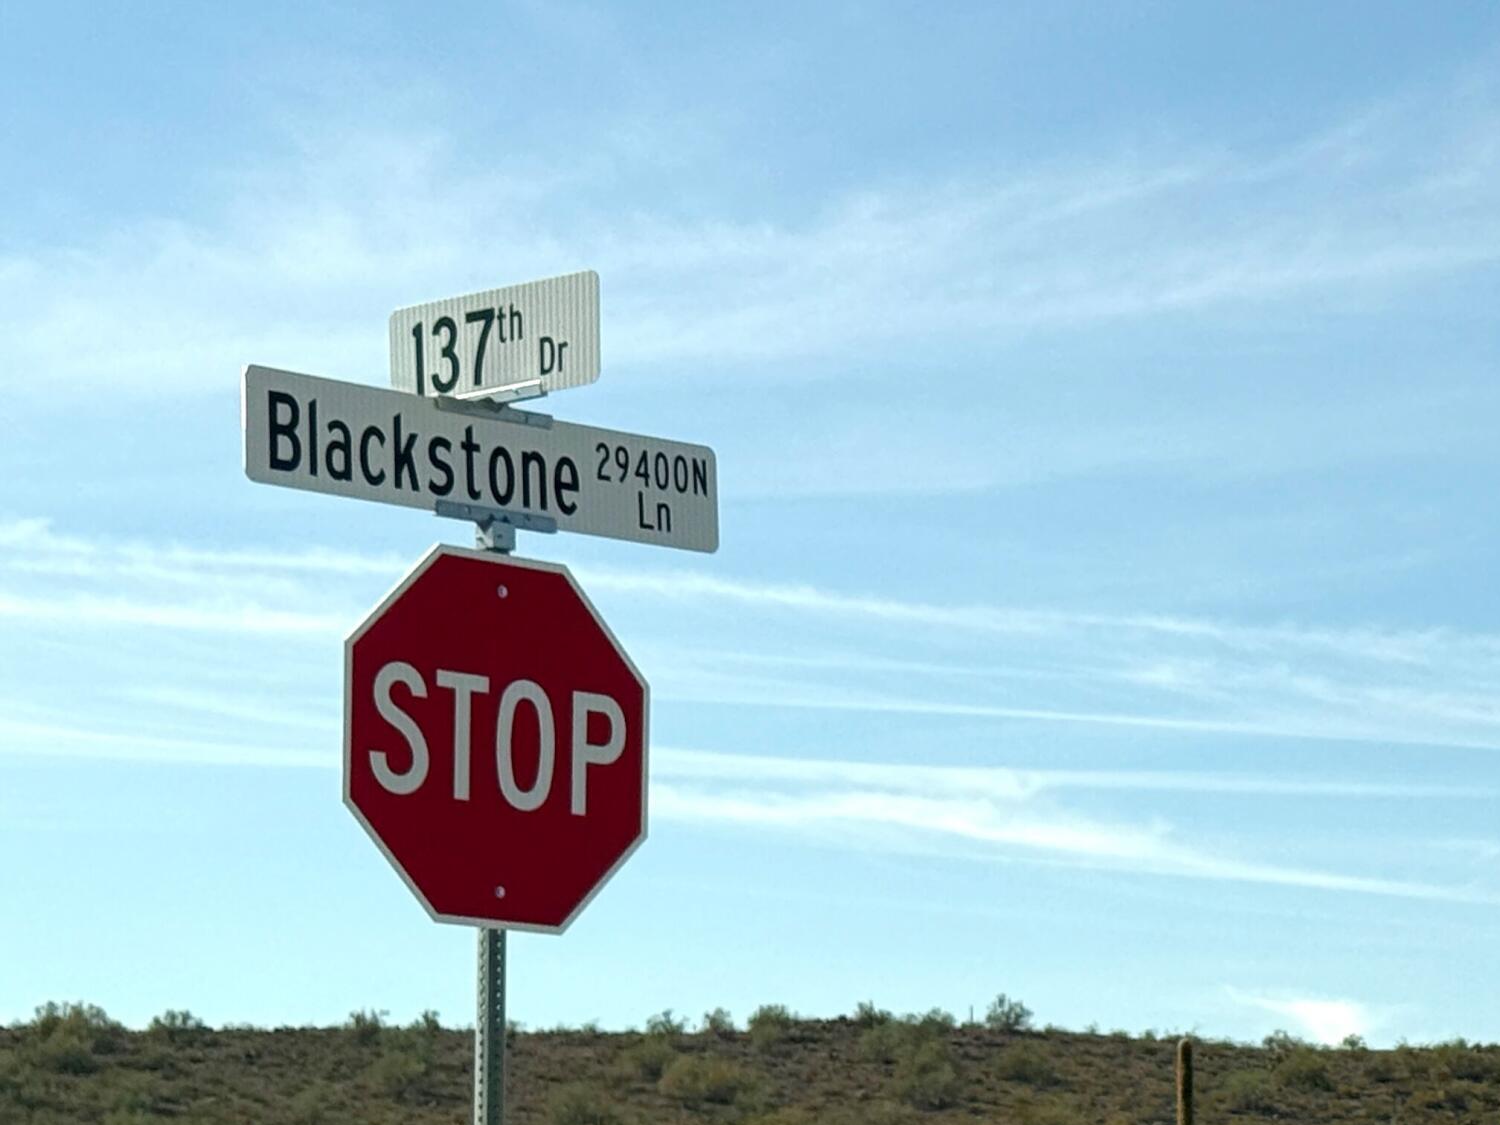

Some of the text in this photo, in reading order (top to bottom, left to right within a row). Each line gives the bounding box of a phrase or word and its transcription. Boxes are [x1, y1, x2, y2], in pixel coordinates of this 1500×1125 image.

[412, 303, 568, 396] 137th Dr
[267, 389, 708, 517] Blackstone 29400N
[638, 491, 671, 533] Ln
[368, 660, 627, 817] STOP
